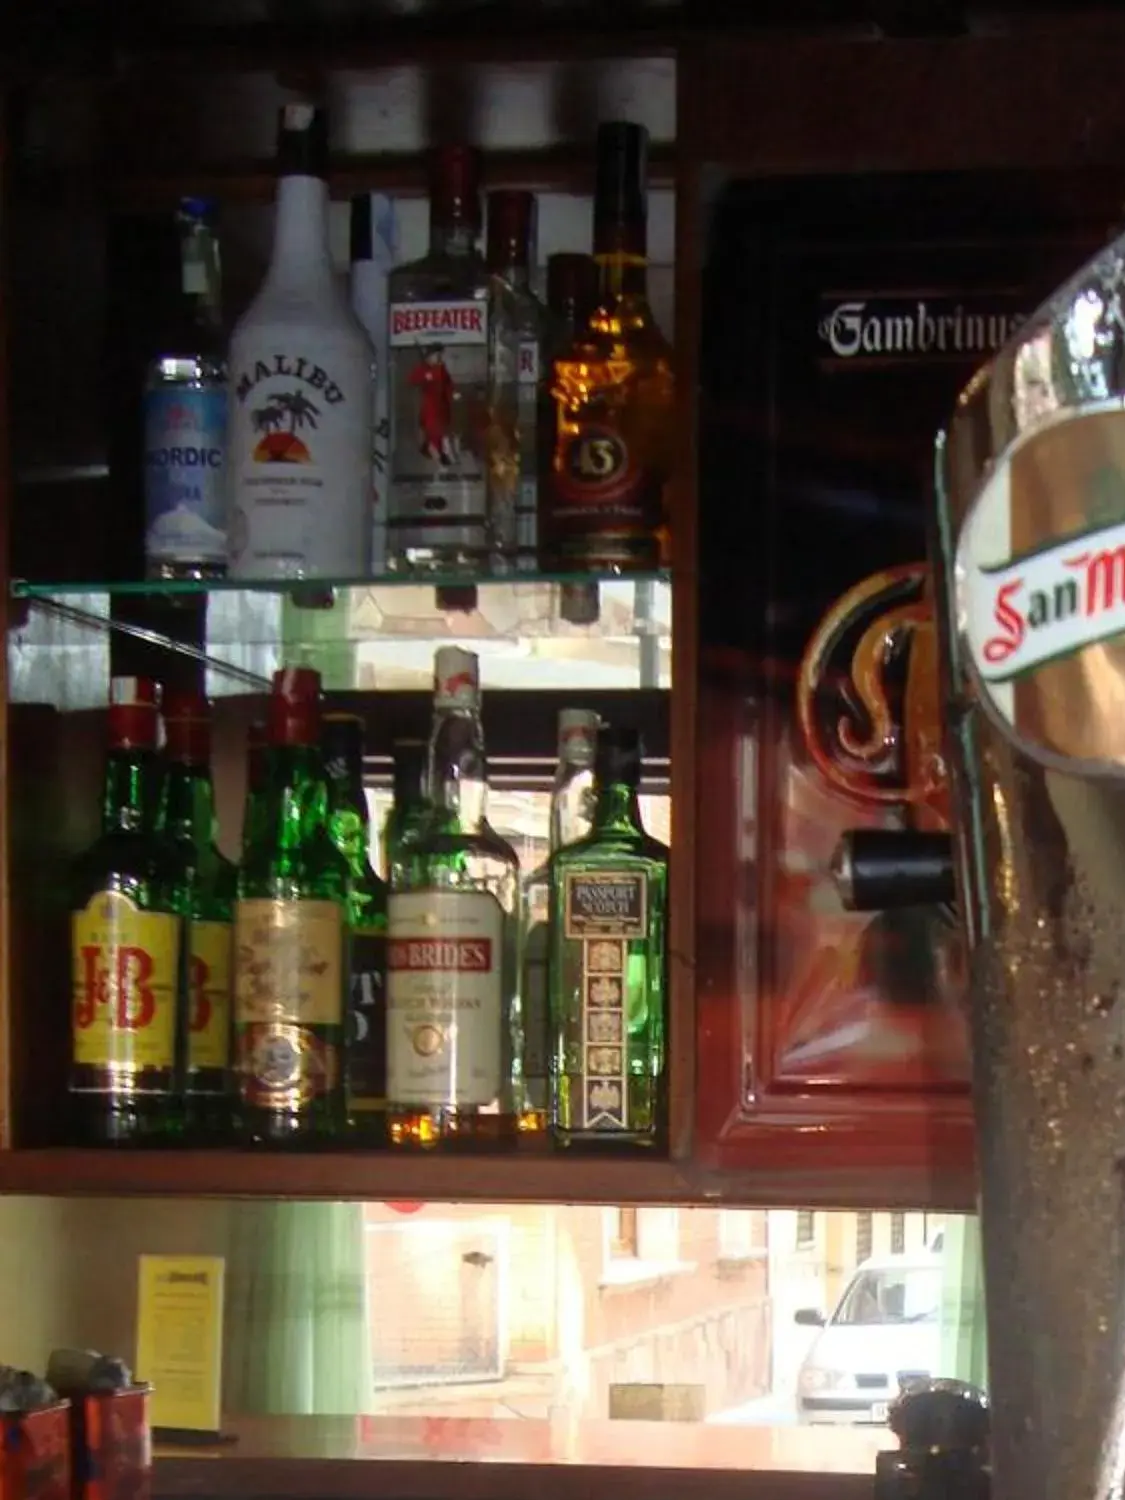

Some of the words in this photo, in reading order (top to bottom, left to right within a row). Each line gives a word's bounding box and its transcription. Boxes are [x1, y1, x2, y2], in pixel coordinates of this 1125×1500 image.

[393, 307, 482, 335] BEEFEATER
[235, 354, 346, 404] MALIBU
[408, 940, 486, 966] BRIDES
[75, 945, 157, 1030] J&B
